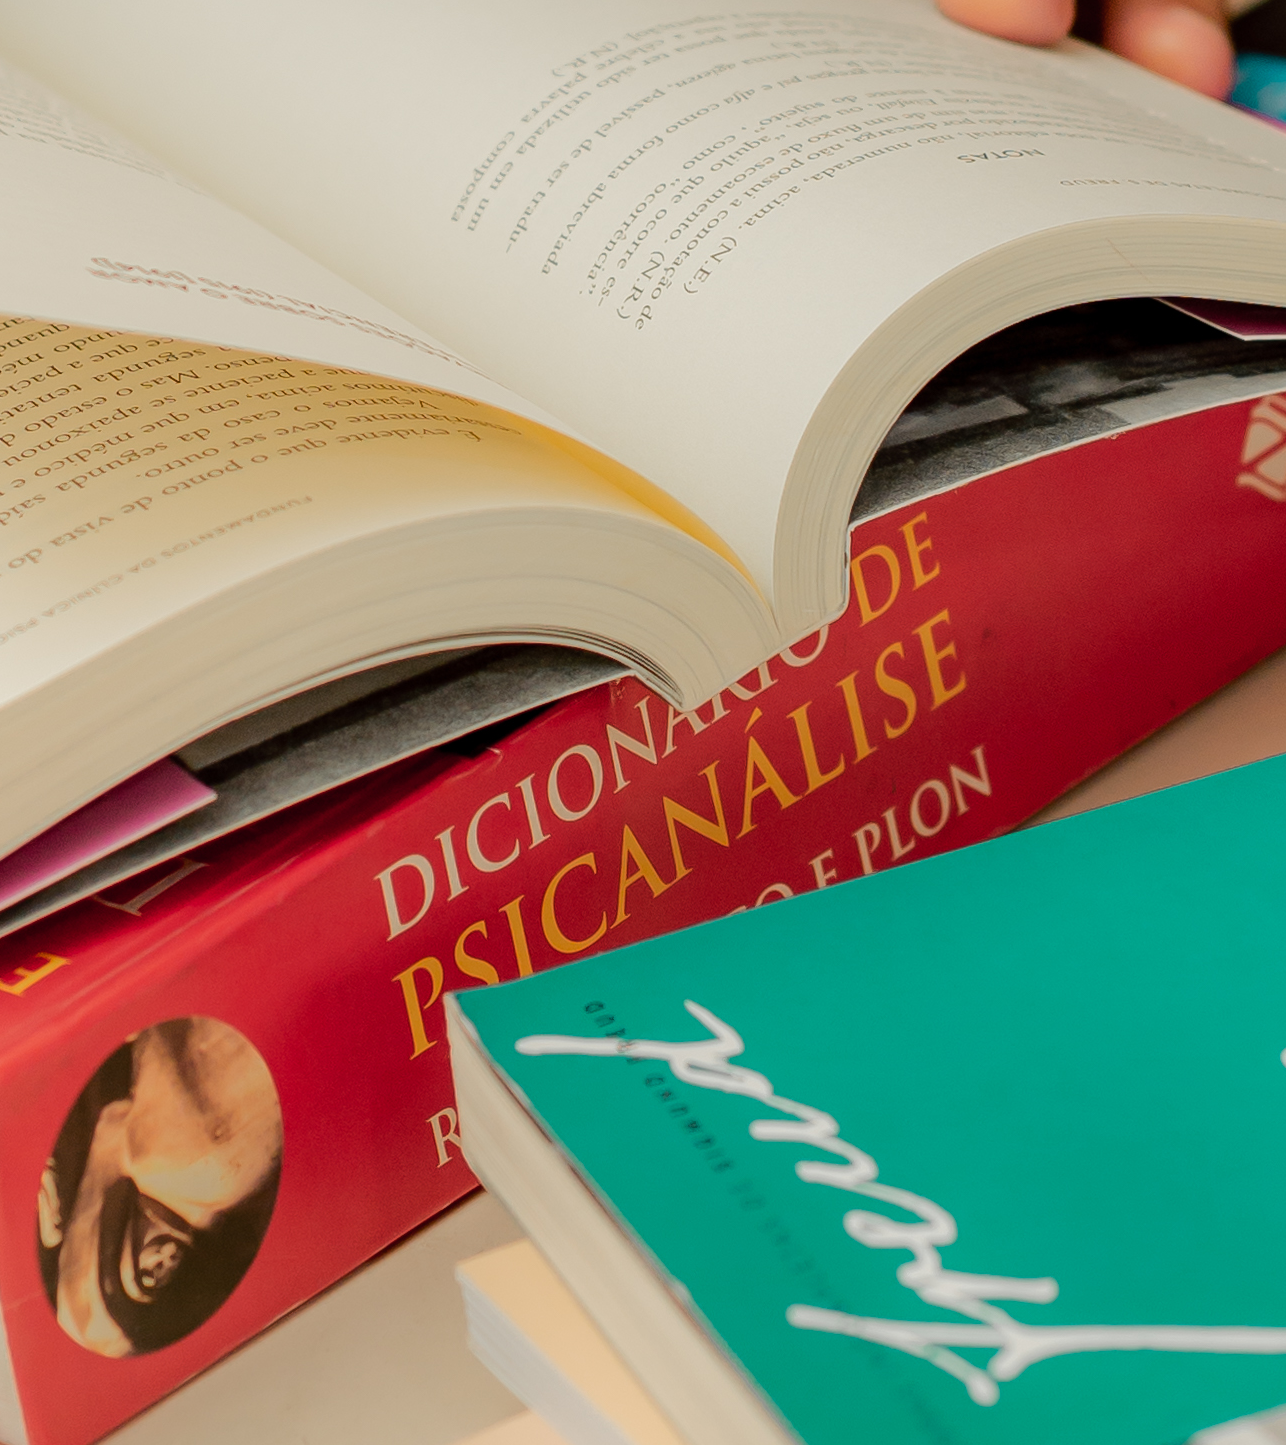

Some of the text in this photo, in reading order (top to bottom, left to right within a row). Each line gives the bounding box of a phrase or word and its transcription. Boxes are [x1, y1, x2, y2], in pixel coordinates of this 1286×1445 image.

[92, 348, 206, 382] segunda
[182, 367, 295, 397] paciente
[245, 384, 336, 400] acima,
[322, 385, 440, 410] Vejamos
[23, 396, 107, 432] estado
[222, 409, 280, 428] caso
[273, 418, 337, 436] deve
[2, 405, 142, 467] apaixonou
[335, 428, 450, 443] evidente
[33, 431, 134, 477] médico
[54, 441, 168, 491] segunda
[135, 447, 219, 478] outro.
[161, 458, 243, 495] ponto
[49, 515, 114, 547] vista
[373, 512, 941, 941] DICIONO DE
[852, 746, 992, 875] PLON
[391, 609, 967, 1060] PSICANÁLISE
